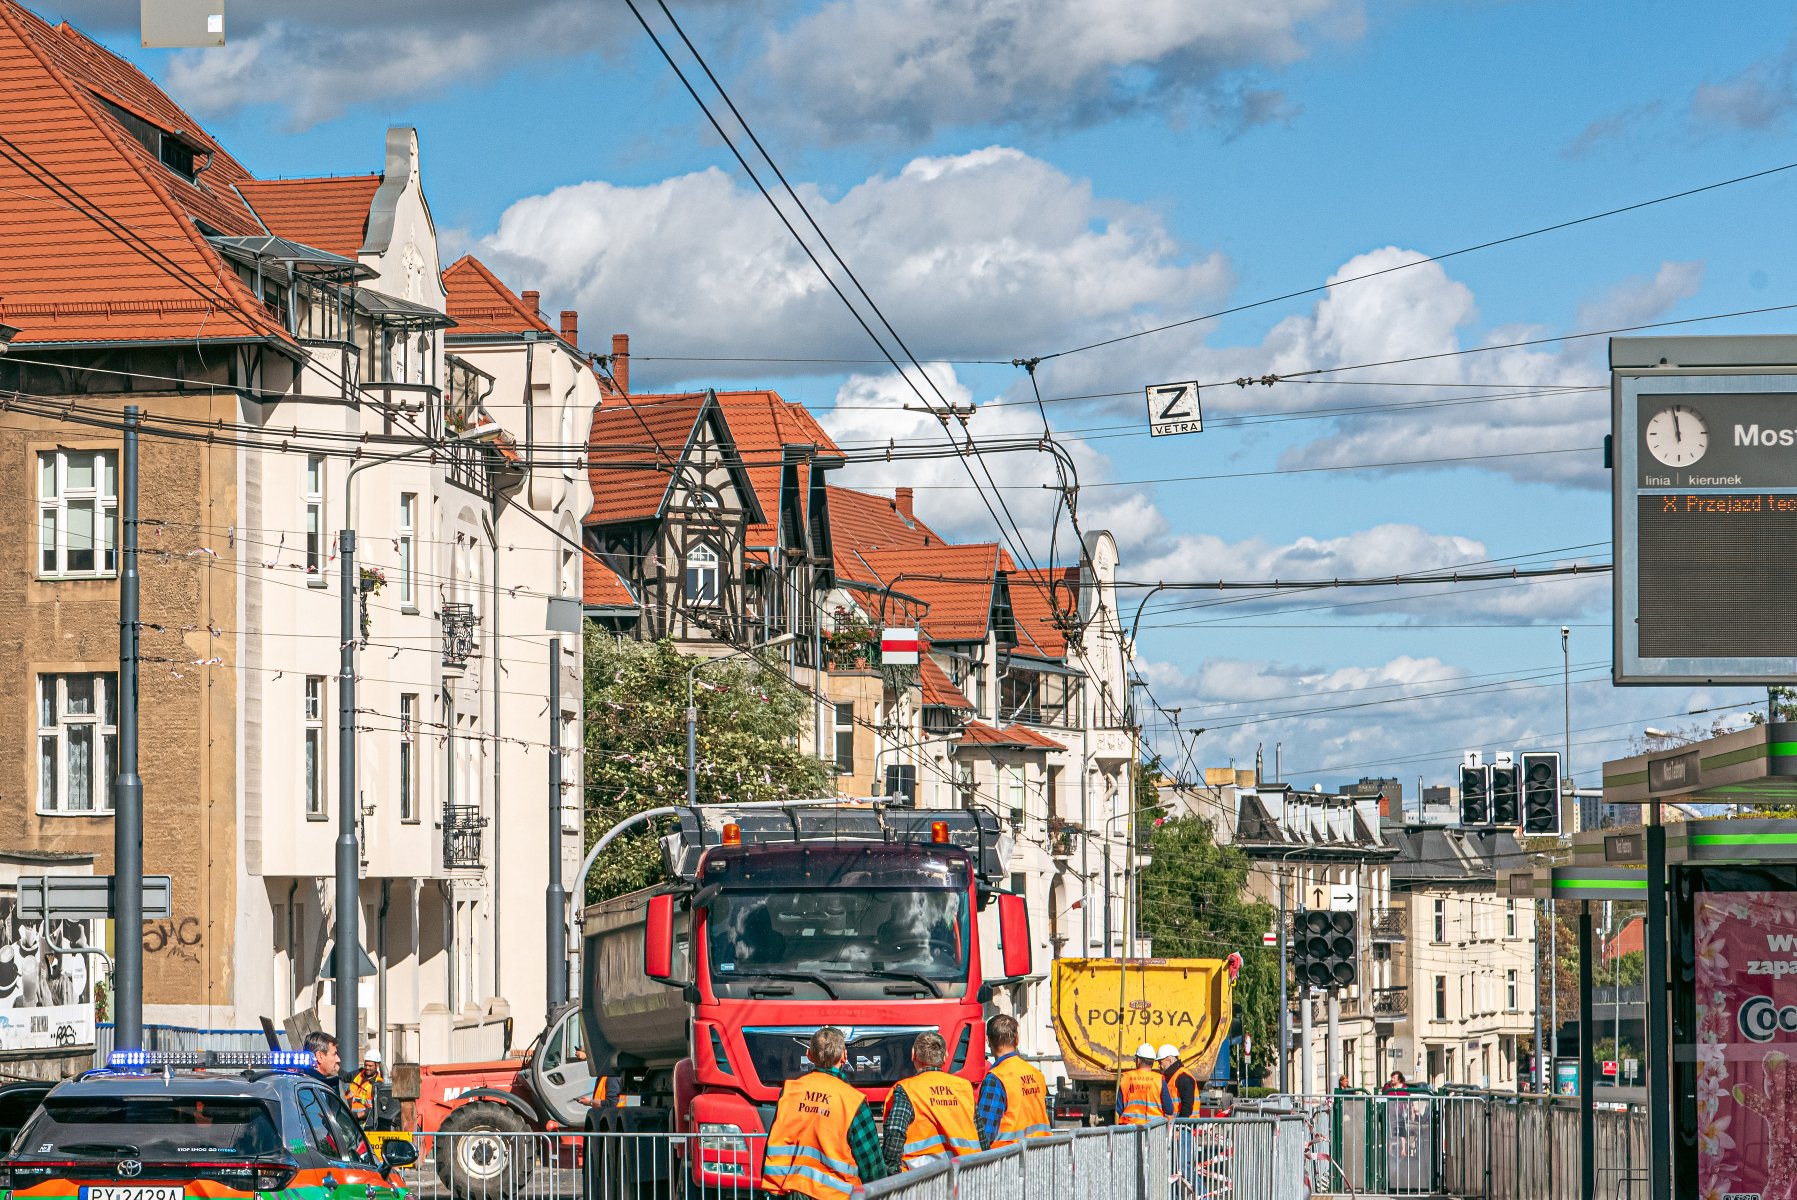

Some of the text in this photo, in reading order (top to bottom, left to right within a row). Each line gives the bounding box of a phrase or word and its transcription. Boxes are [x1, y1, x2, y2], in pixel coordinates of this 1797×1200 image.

[1157, 386, 1190, 419] Z
[1155, 423, 1198, 434] VETRA
[1734, 424, 1797, 447] Mos
[1645, 474, 1742, 486] linia kierunek
[1663, 495, 1677, 512] X
[1687, 495, 1761, 514] Przejazd
[1766, 934, 1797, 957] W
[804, 1090, 832, 1106] MPK
[929, 1085, 954, 1096] MPK
